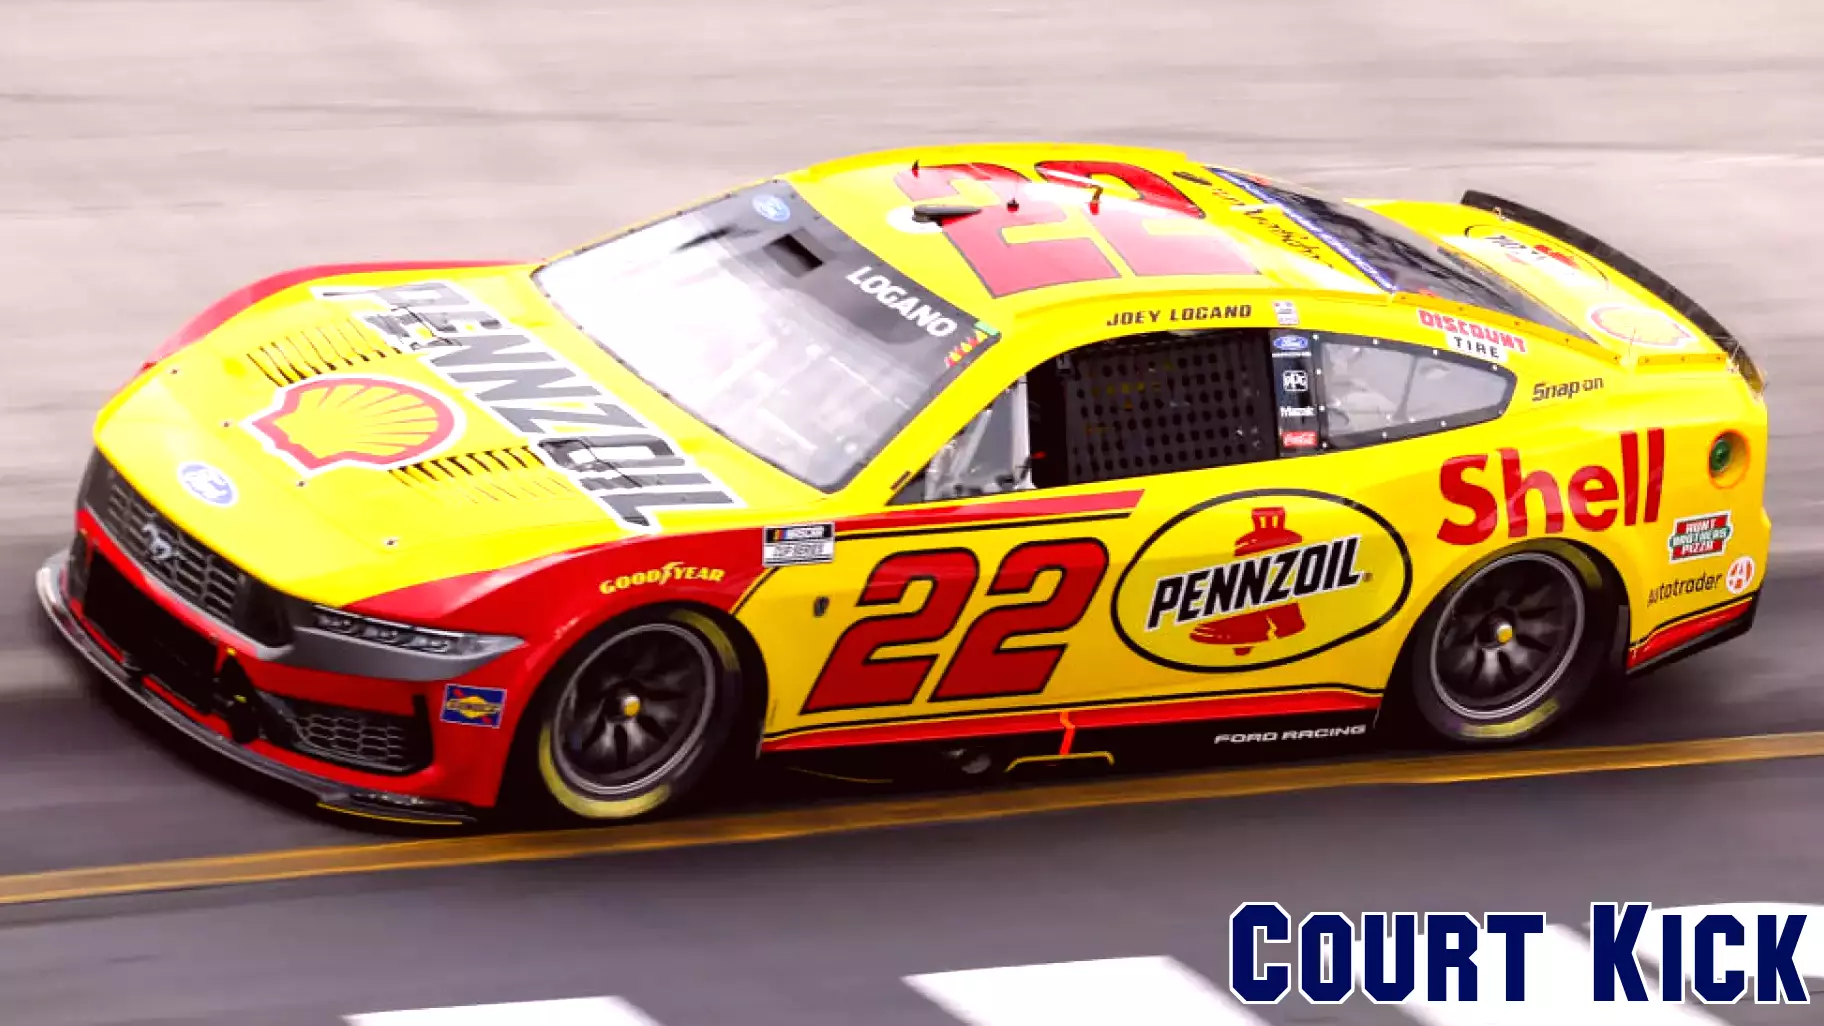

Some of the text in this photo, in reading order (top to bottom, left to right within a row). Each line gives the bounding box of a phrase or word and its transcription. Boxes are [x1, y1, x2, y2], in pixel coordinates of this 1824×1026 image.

[893, 160, 1263, 299] 22
[845, 265, 958, 337] LOGANO
[1106, 309, 1162, 327] JOEY
[1170, 304, 1253, 322] LOGANO
[1418, 309, 1527, 352] DISCOUNT
[1453, 336, 1500, 358] TIRE
[318, 281, 738, 528] PENNZOIL
[1437, 427, 1665, 546] Shell
[599, 561, 727, 595] GOODYEAR
[799, 537, 1110, 715] 22
[1214, 724, 1367, 745] FORD RACING
